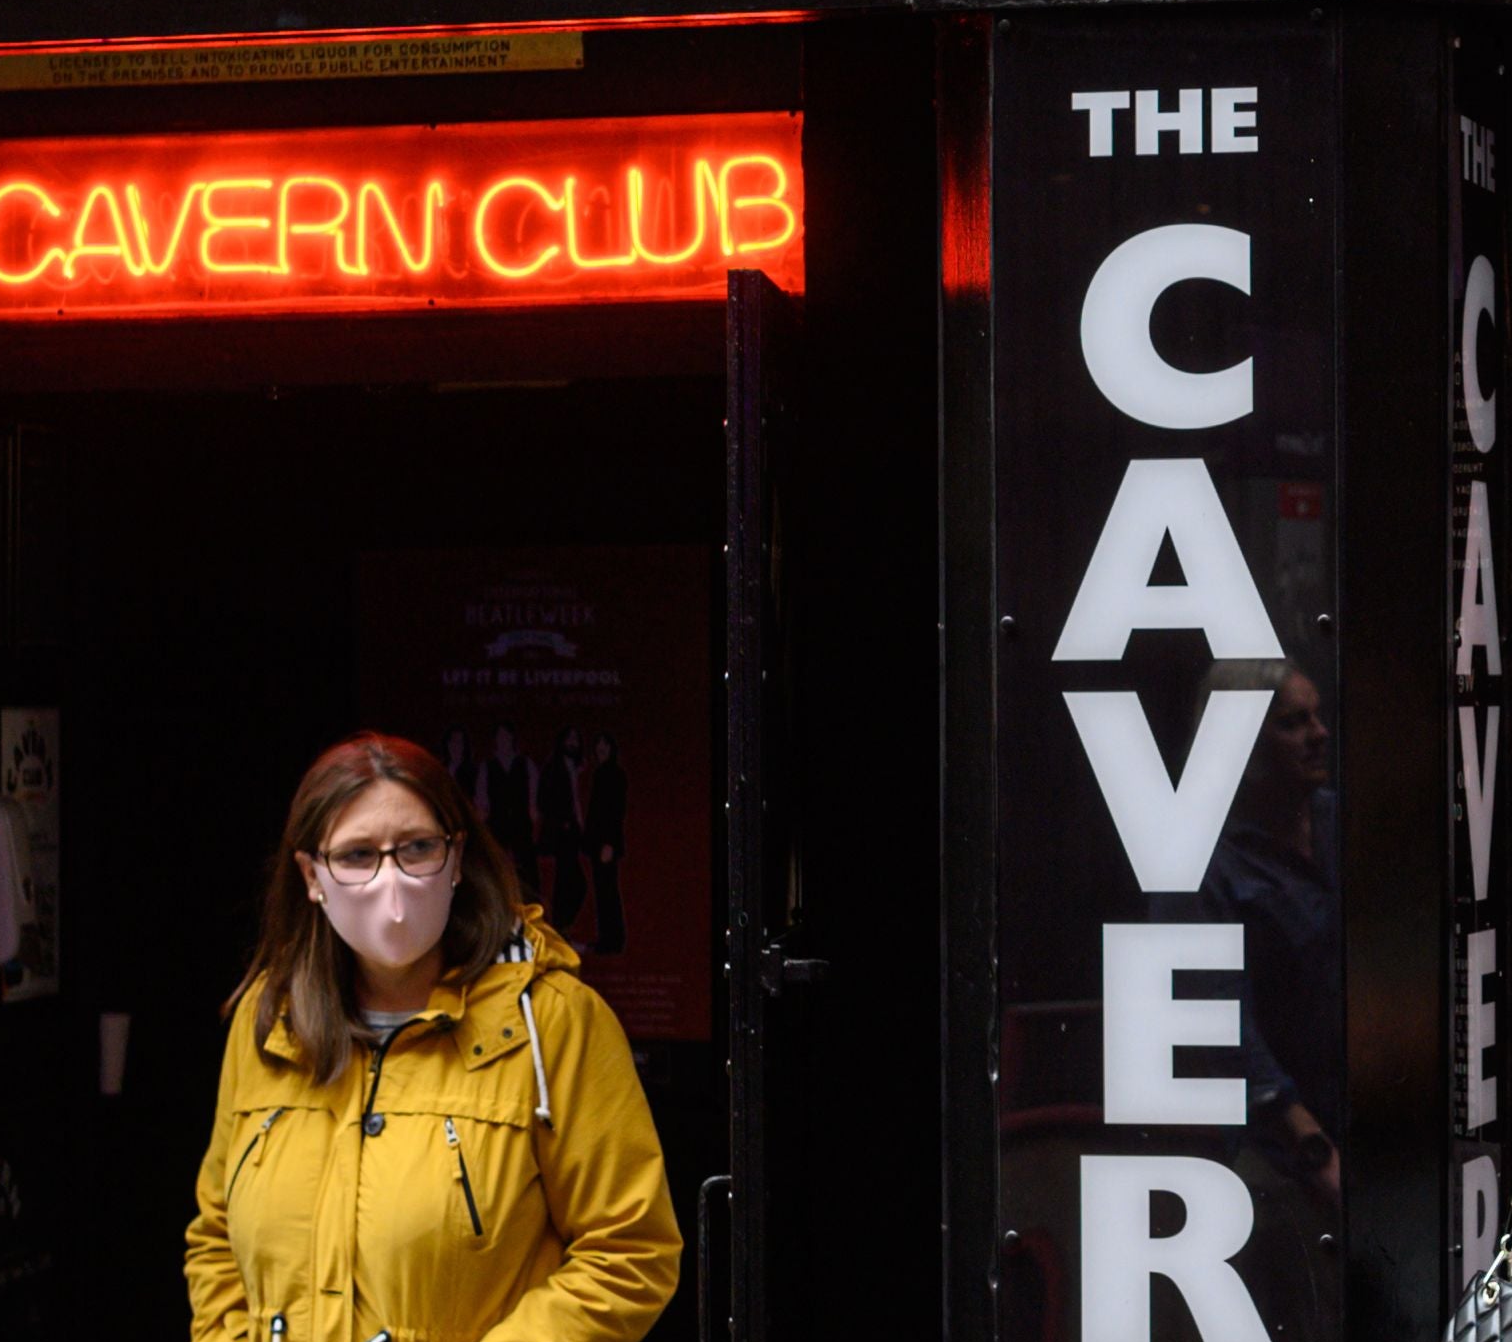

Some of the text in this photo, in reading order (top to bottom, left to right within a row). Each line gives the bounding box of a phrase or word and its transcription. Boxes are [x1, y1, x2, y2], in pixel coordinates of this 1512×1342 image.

[53, 53, 508, 84] ON THE PREMISES AND TO PROVIDE PUBLIC ENTERTAINMENT
[300, 44, 357, 60] LIQUOR
[363, 43, 393, 58] FOR
[399, 39, 510, 57] CONSUMPTION
[1071, 87, 1260, 158] THE
[1460, 115, 1495, 193] THE
[475, 157, 796, 278] CLUB
